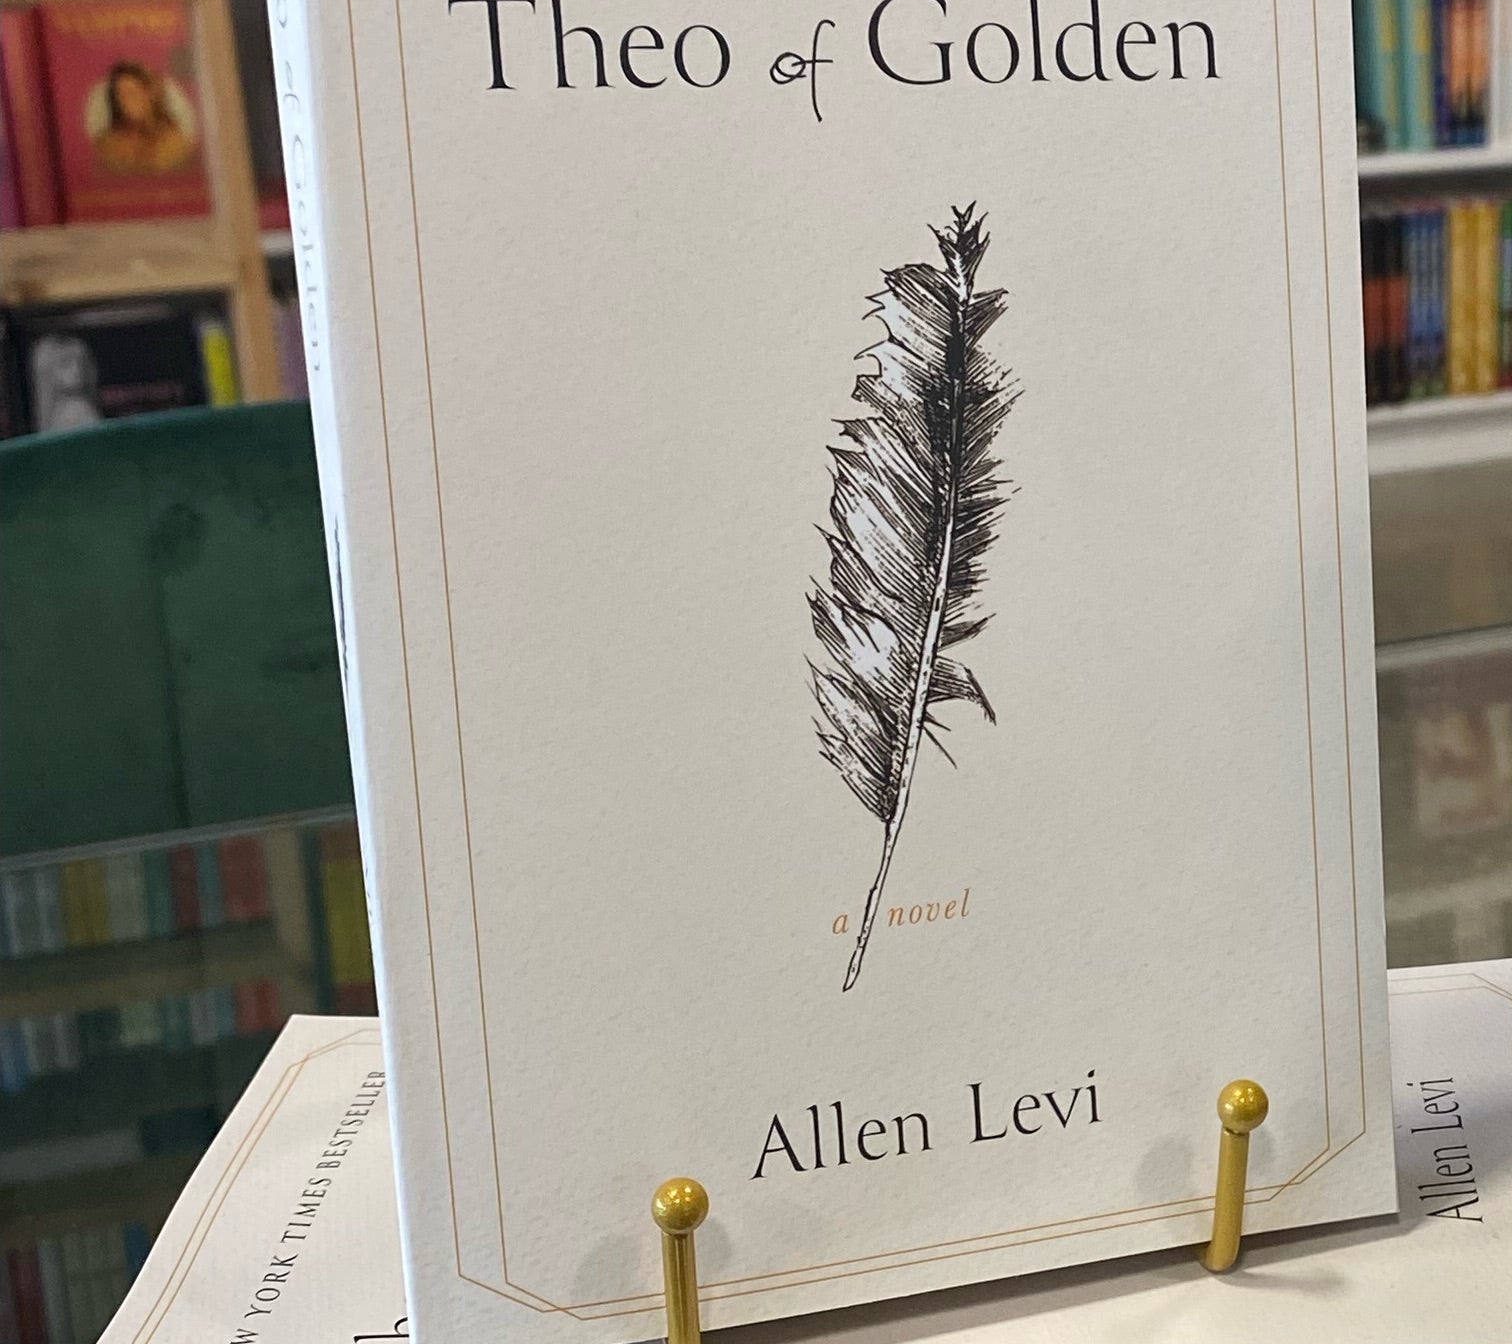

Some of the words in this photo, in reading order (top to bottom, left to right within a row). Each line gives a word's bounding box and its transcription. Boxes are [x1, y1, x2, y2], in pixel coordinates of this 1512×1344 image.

[770, 19, 836, 122] of
[292, 133, 322, 372] Golden
[832, 913, 850, 934] a
[888, 888, 971, 927] novel
[750, 1101, 933, 1180] Allen
[966, 1069, 1103, 1144] Levi
[1406, 1077, 1464, 1134] Levi
[244, 1255, 299, 1320] YORK
[281, 1175, 333, 1244] TIMES
[317, 1069, 386, 1169] BESTSELLER
[1418, 1144, 1484, 1224] Allen
